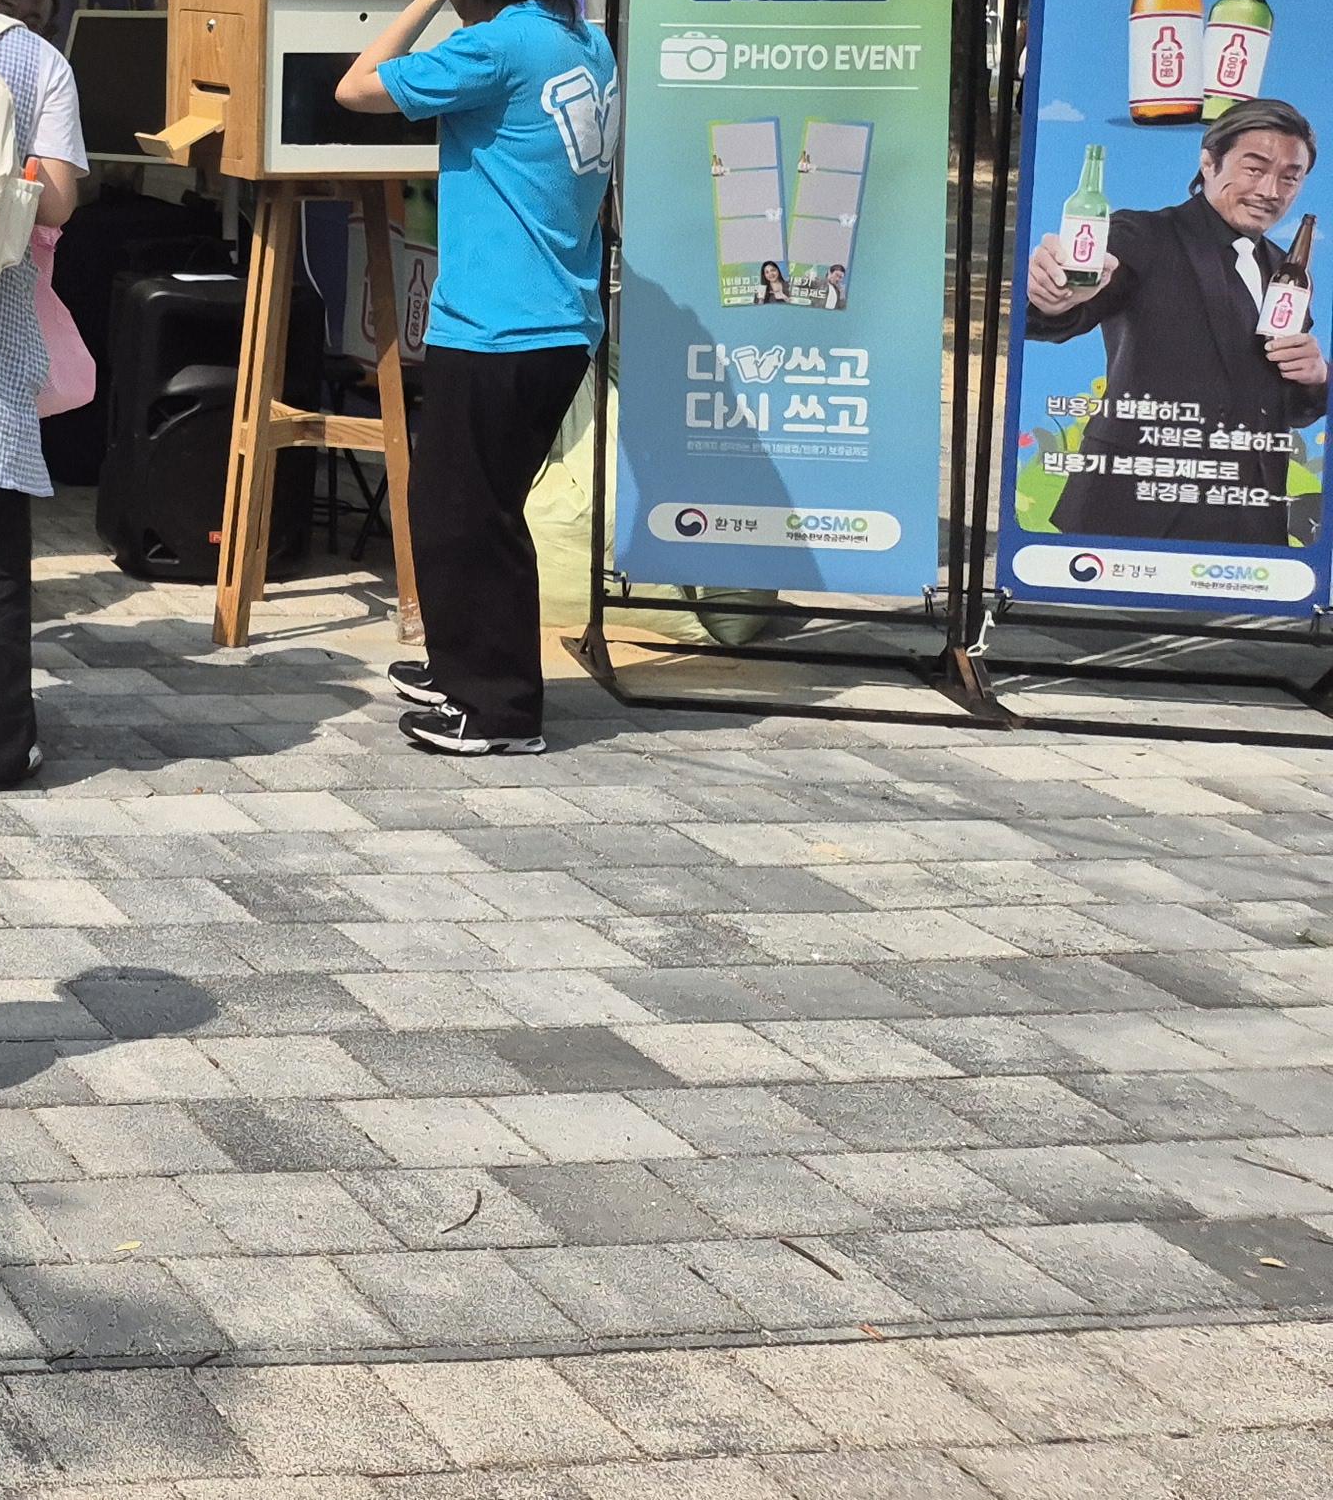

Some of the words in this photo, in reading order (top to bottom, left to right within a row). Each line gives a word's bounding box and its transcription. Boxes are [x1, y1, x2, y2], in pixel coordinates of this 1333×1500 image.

[734, 44, 828, 70] PHOTO
[835, 44, 921, 70] EVENT
[686, 344, 728, 382] 다
[784, 348, 870, 386] 쓰고
[685, 391, 769, 432] 다시
[783, 396, 870, 435] 쓰고
[1046, 396, 1110, 419] 빈용기
[1138, 426, 1203, 448] 자원은
[1043, 452, 1107, 475] 빈용기
[1111, 456, 1240, 480] 보증금제도로
[1136, 481, 1200, 503] 환경을
[715, 517, 758, 532] 환경부
[786, 513, 868, 533] COSMO
[1111, 563, 1157, 579] 환경부
[1191, 563, 1270, 581] COSMO
